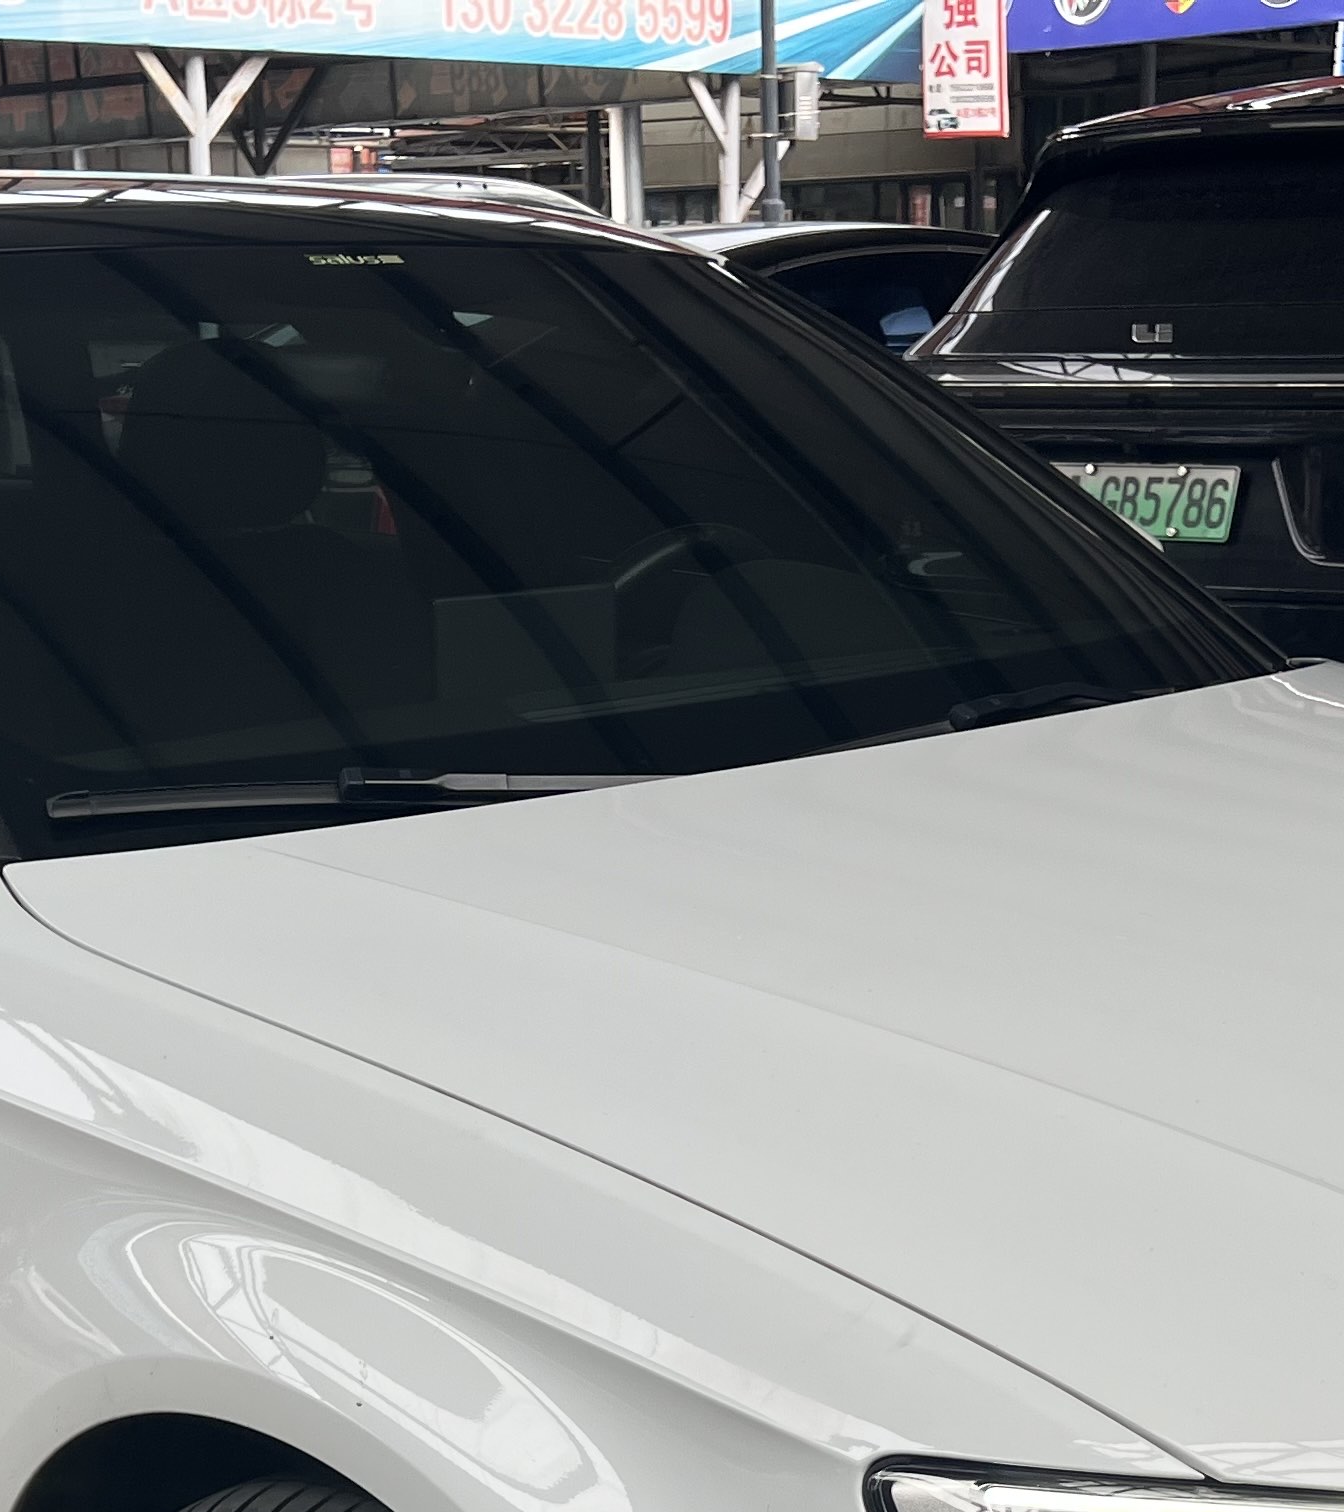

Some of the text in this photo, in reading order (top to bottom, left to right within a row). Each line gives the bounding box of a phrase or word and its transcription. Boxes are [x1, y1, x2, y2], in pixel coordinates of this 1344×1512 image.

[525, 0, 625, 39] 3228
[637, 0, 730, 43] 5599
[929, 40, 991, 78] 公司
[1101, 476, 1229, 529] GB5786
